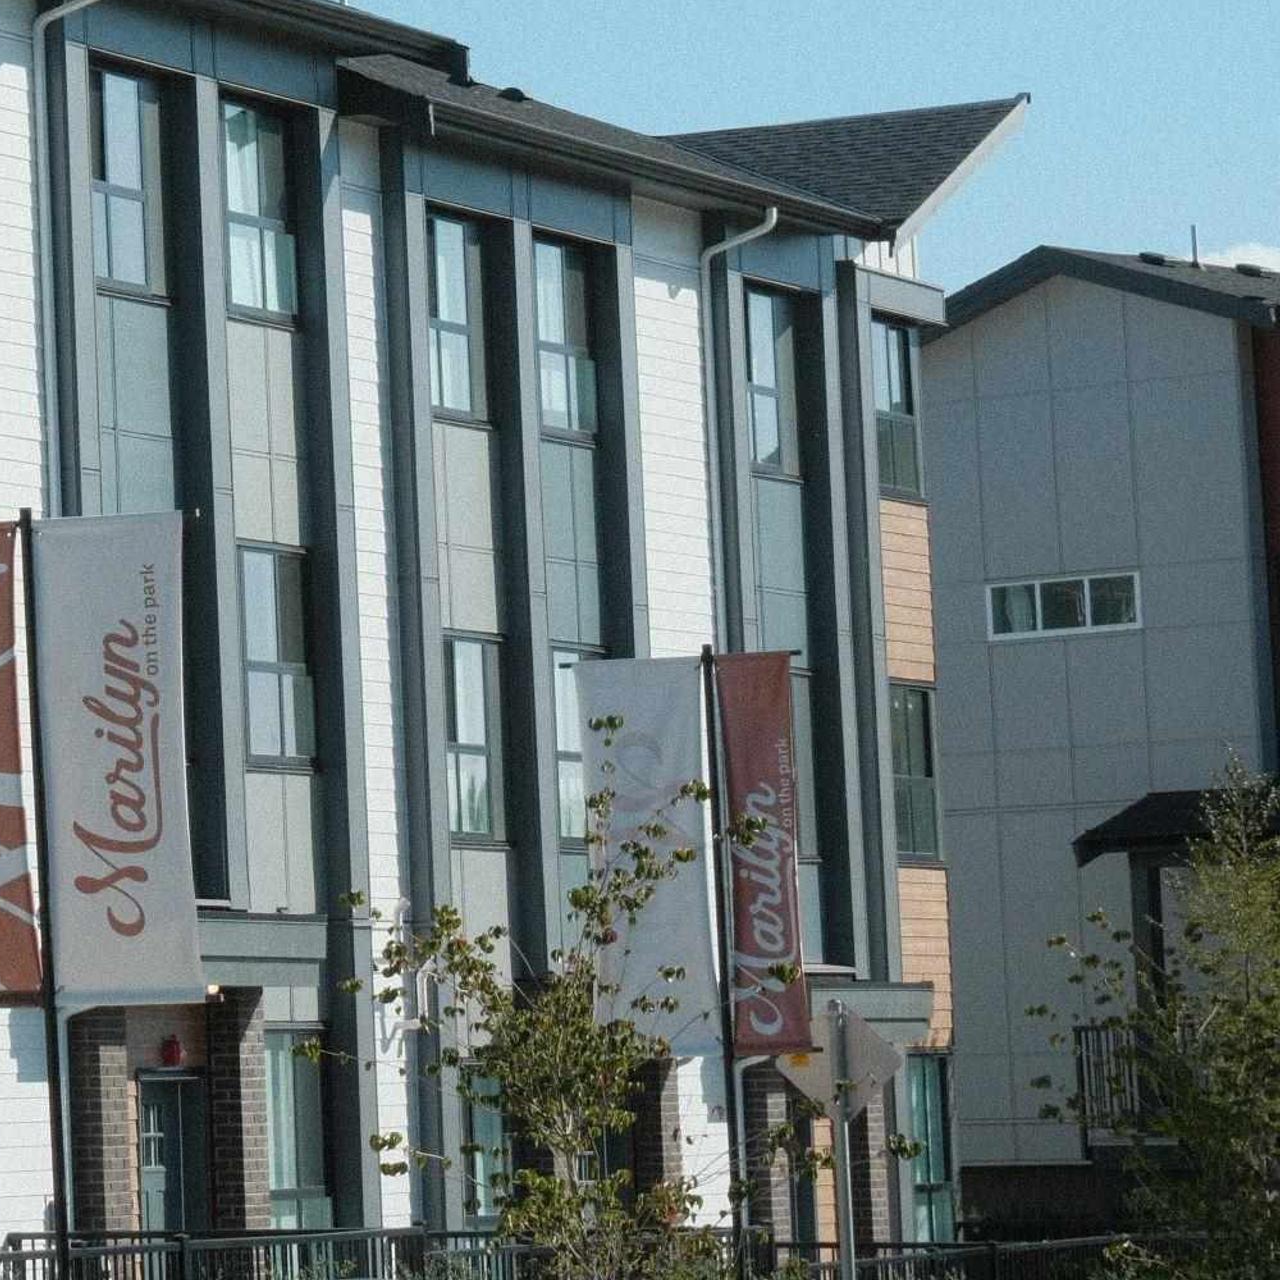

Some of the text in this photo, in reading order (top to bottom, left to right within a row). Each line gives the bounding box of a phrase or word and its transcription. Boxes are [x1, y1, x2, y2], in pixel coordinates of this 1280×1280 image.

[140, 563, 159, 676] on the park
[73, 619, 162, 937] Marilyn
